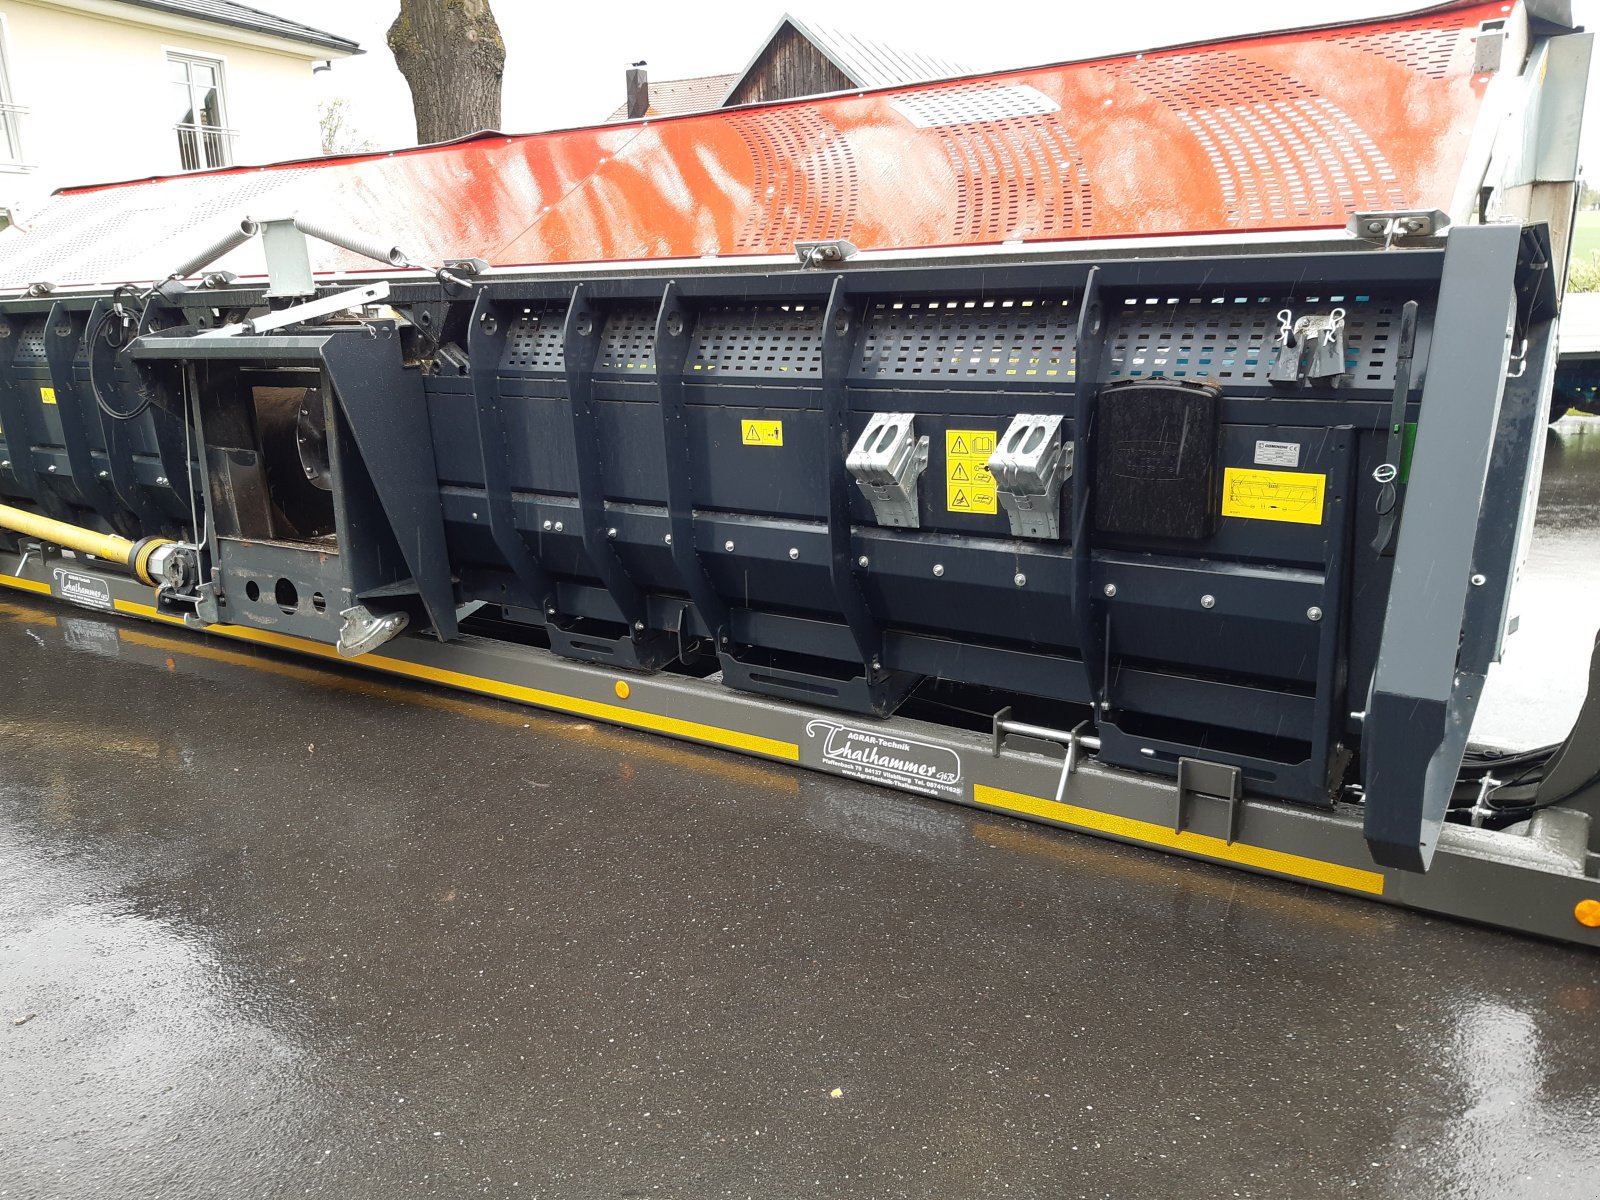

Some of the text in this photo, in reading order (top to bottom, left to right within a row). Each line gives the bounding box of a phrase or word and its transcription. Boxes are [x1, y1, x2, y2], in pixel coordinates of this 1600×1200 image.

[806, 719, 936, 777] Thalhammer
[848, 732, 910, 752] AGRAR-Technik
[914, 778, 925, 786] Tel.
